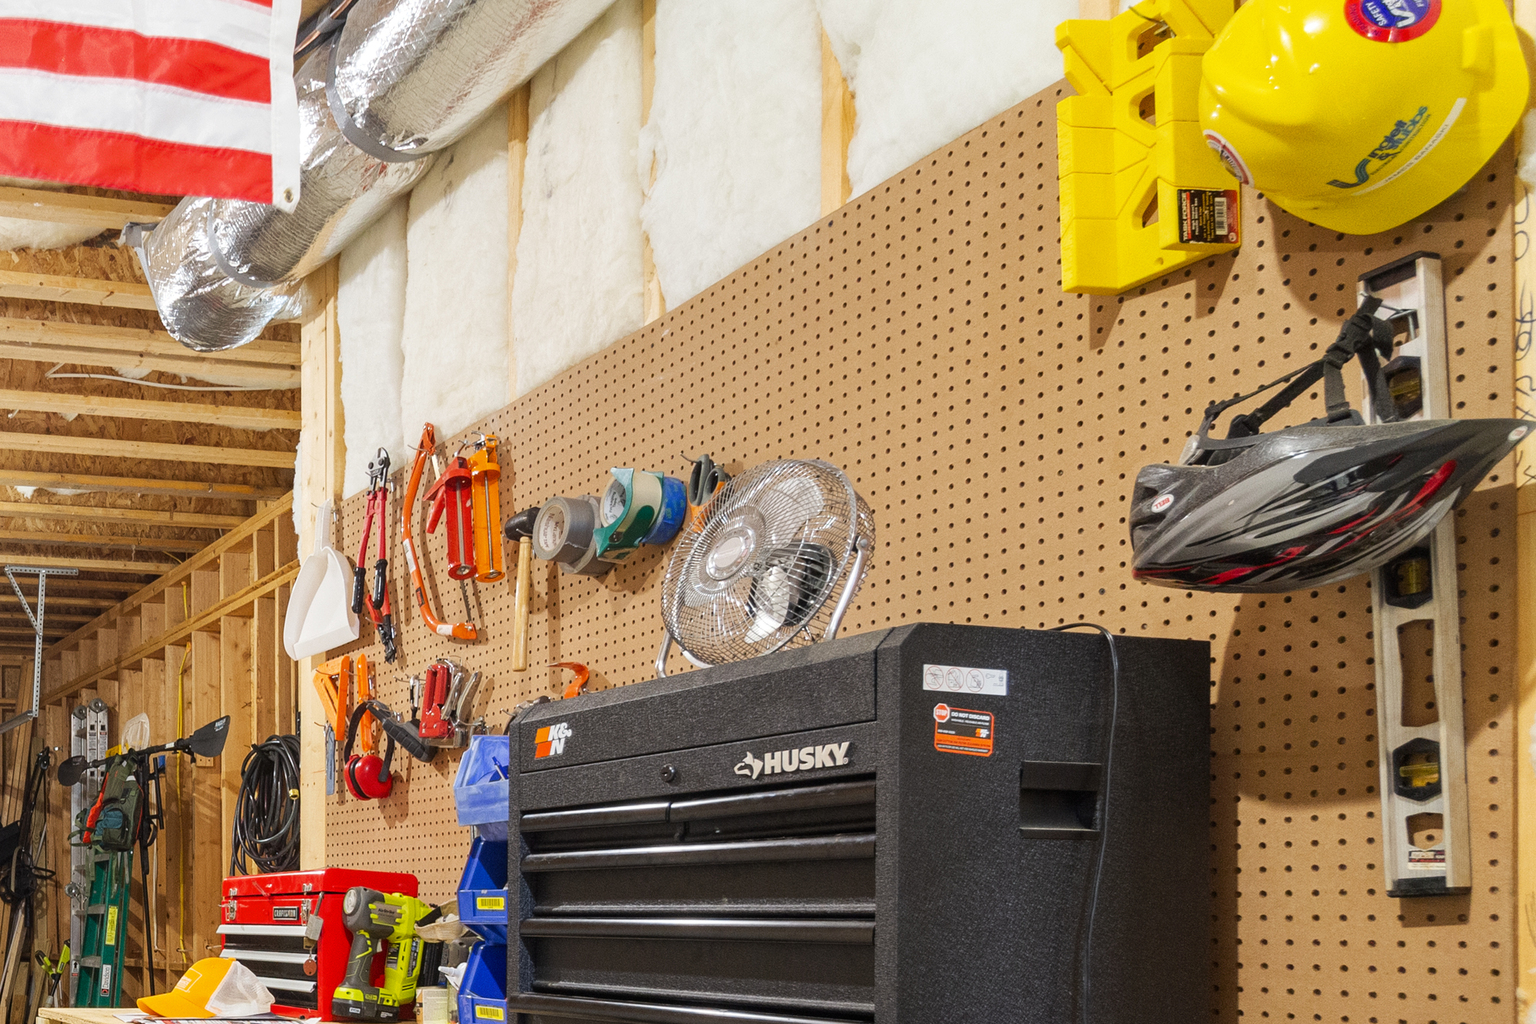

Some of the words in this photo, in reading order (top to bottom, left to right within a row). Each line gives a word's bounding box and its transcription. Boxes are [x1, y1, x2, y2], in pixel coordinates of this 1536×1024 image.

[1365, 1, 1387, 26] SAFETY
[935, 708, 949, 717] STOP
[969, 713, 991, 721] DISCARD
[764, 741, 850, 775] HUSKY
